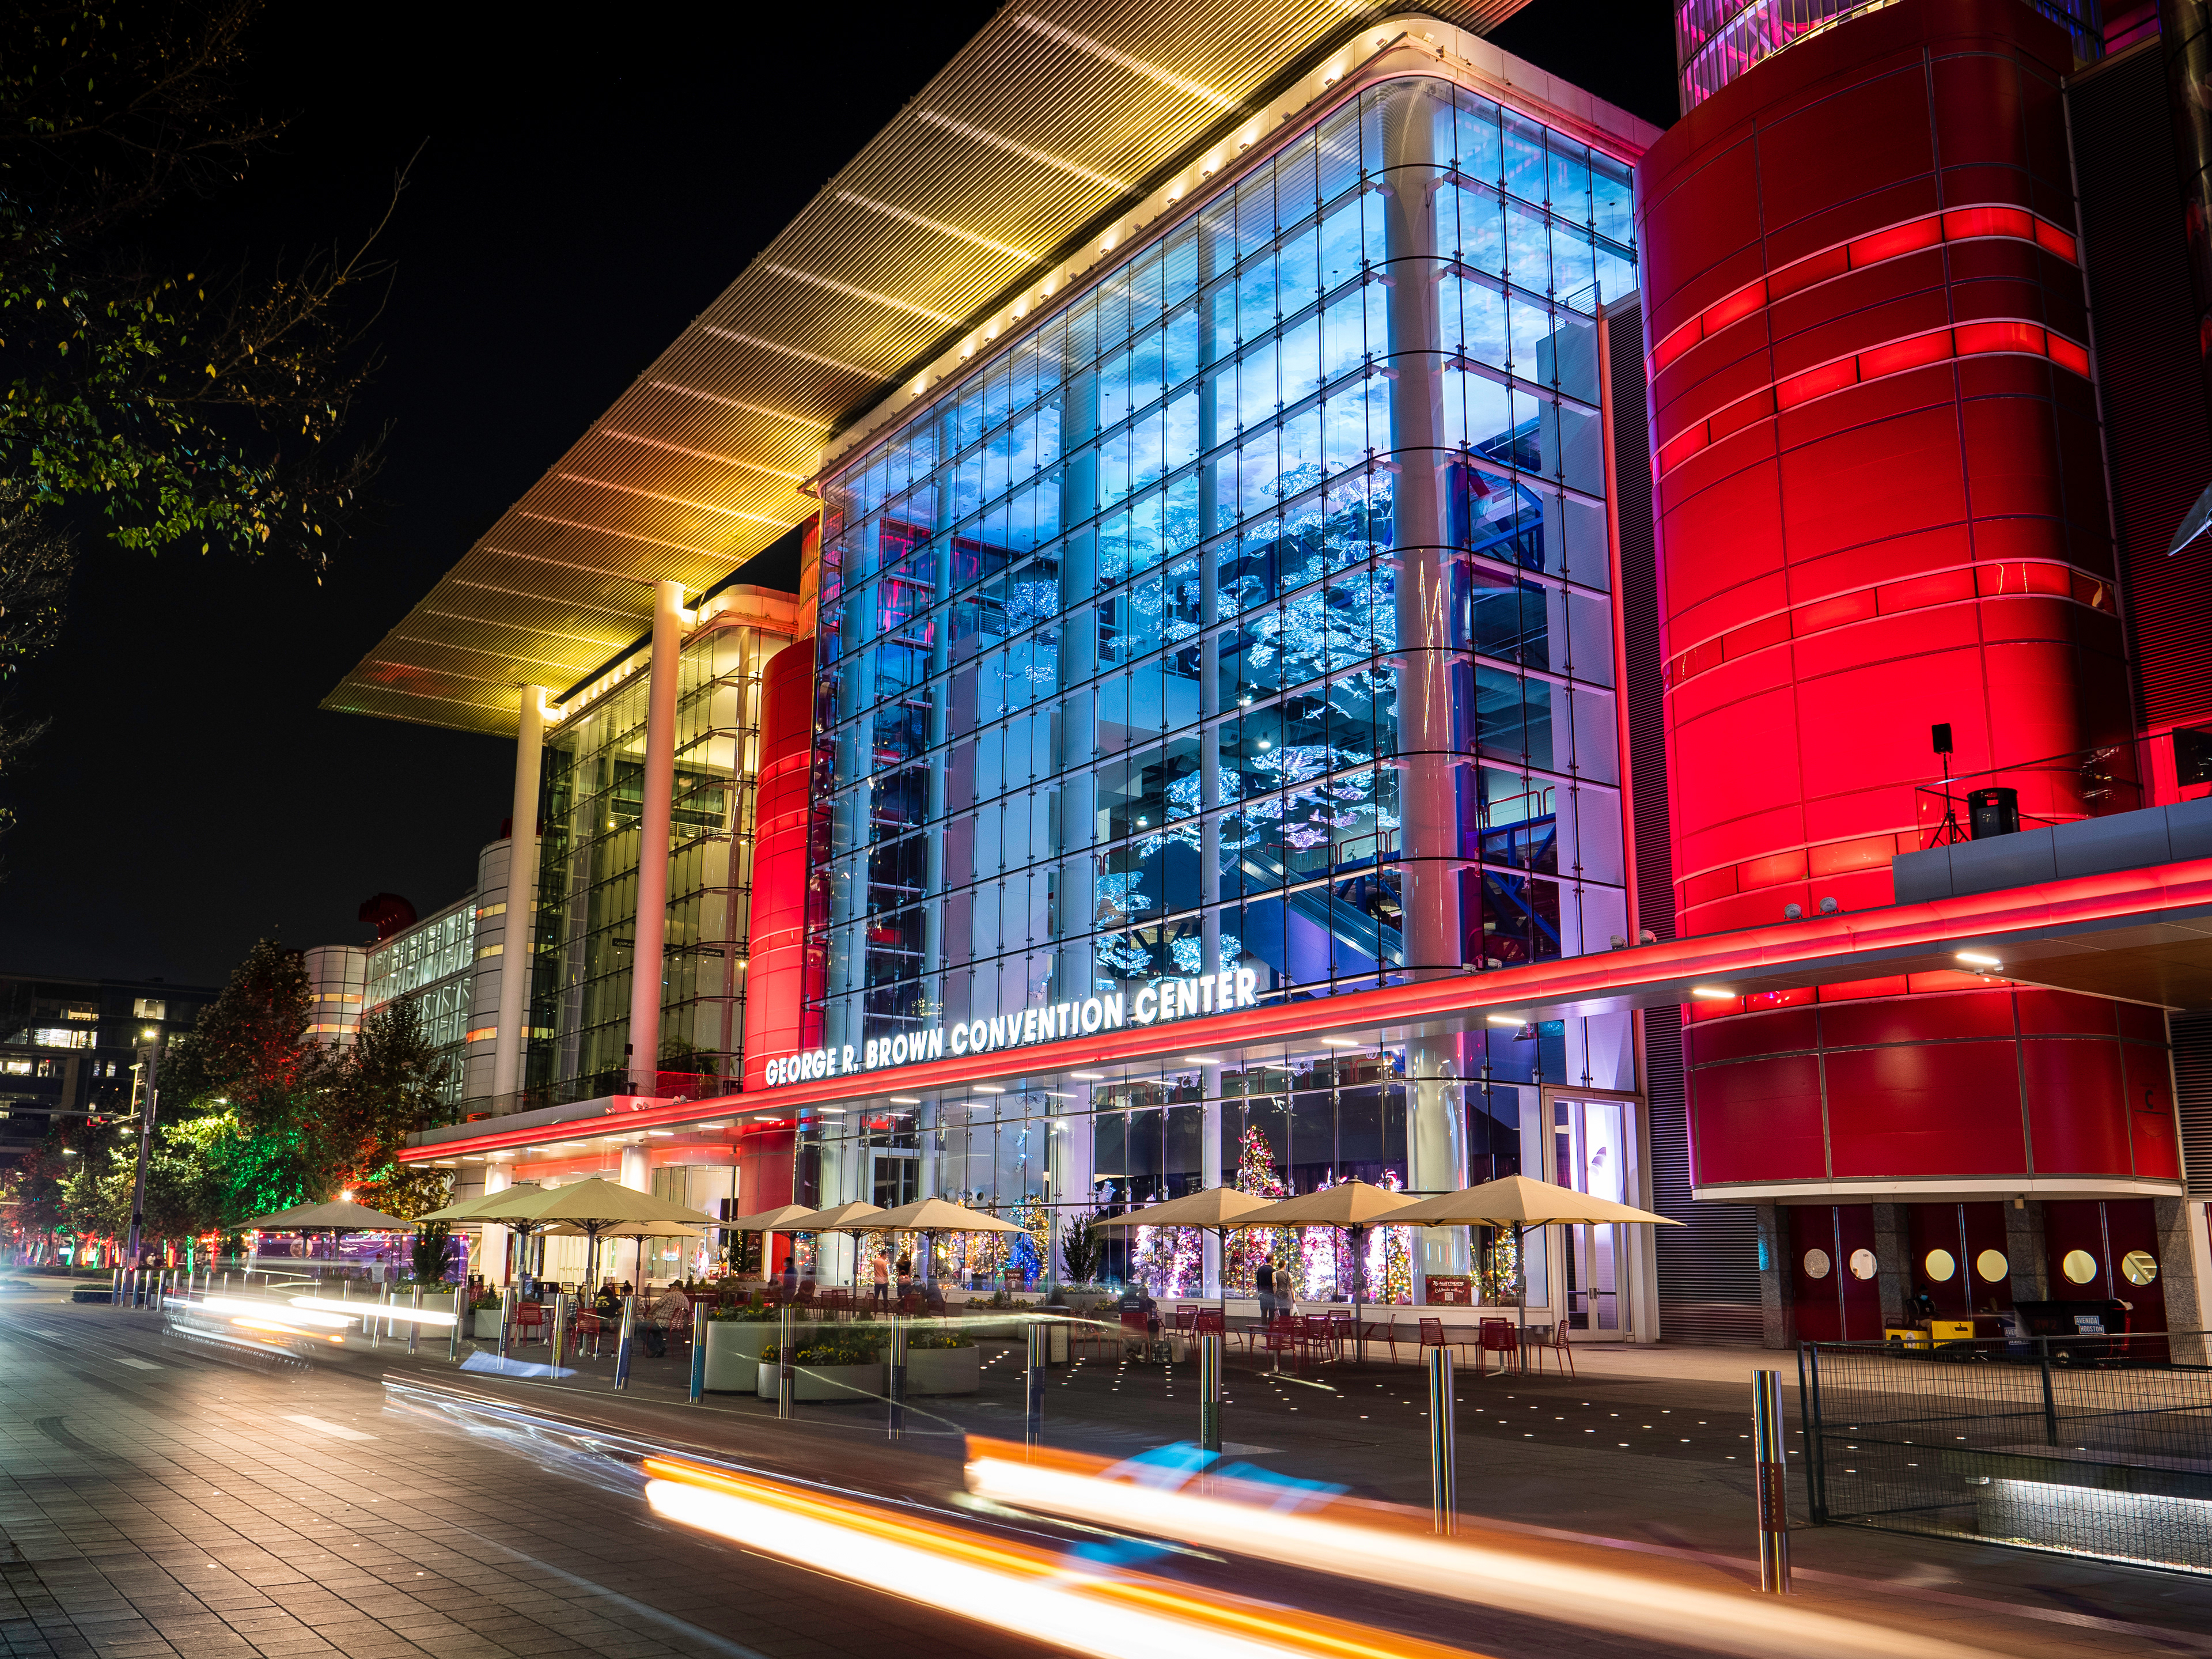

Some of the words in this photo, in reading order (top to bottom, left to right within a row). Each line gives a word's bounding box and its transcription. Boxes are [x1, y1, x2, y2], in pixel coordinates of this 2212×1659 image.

[766, 1047, 836, 1086] GEORGE
[842, 1044, 859, 1074] R.
[866, 1027, 944, 1070] BROWN
[951, 992, 1124, 1055] CONVENTION
[1135, 968, 1257, 1024] CENTER
